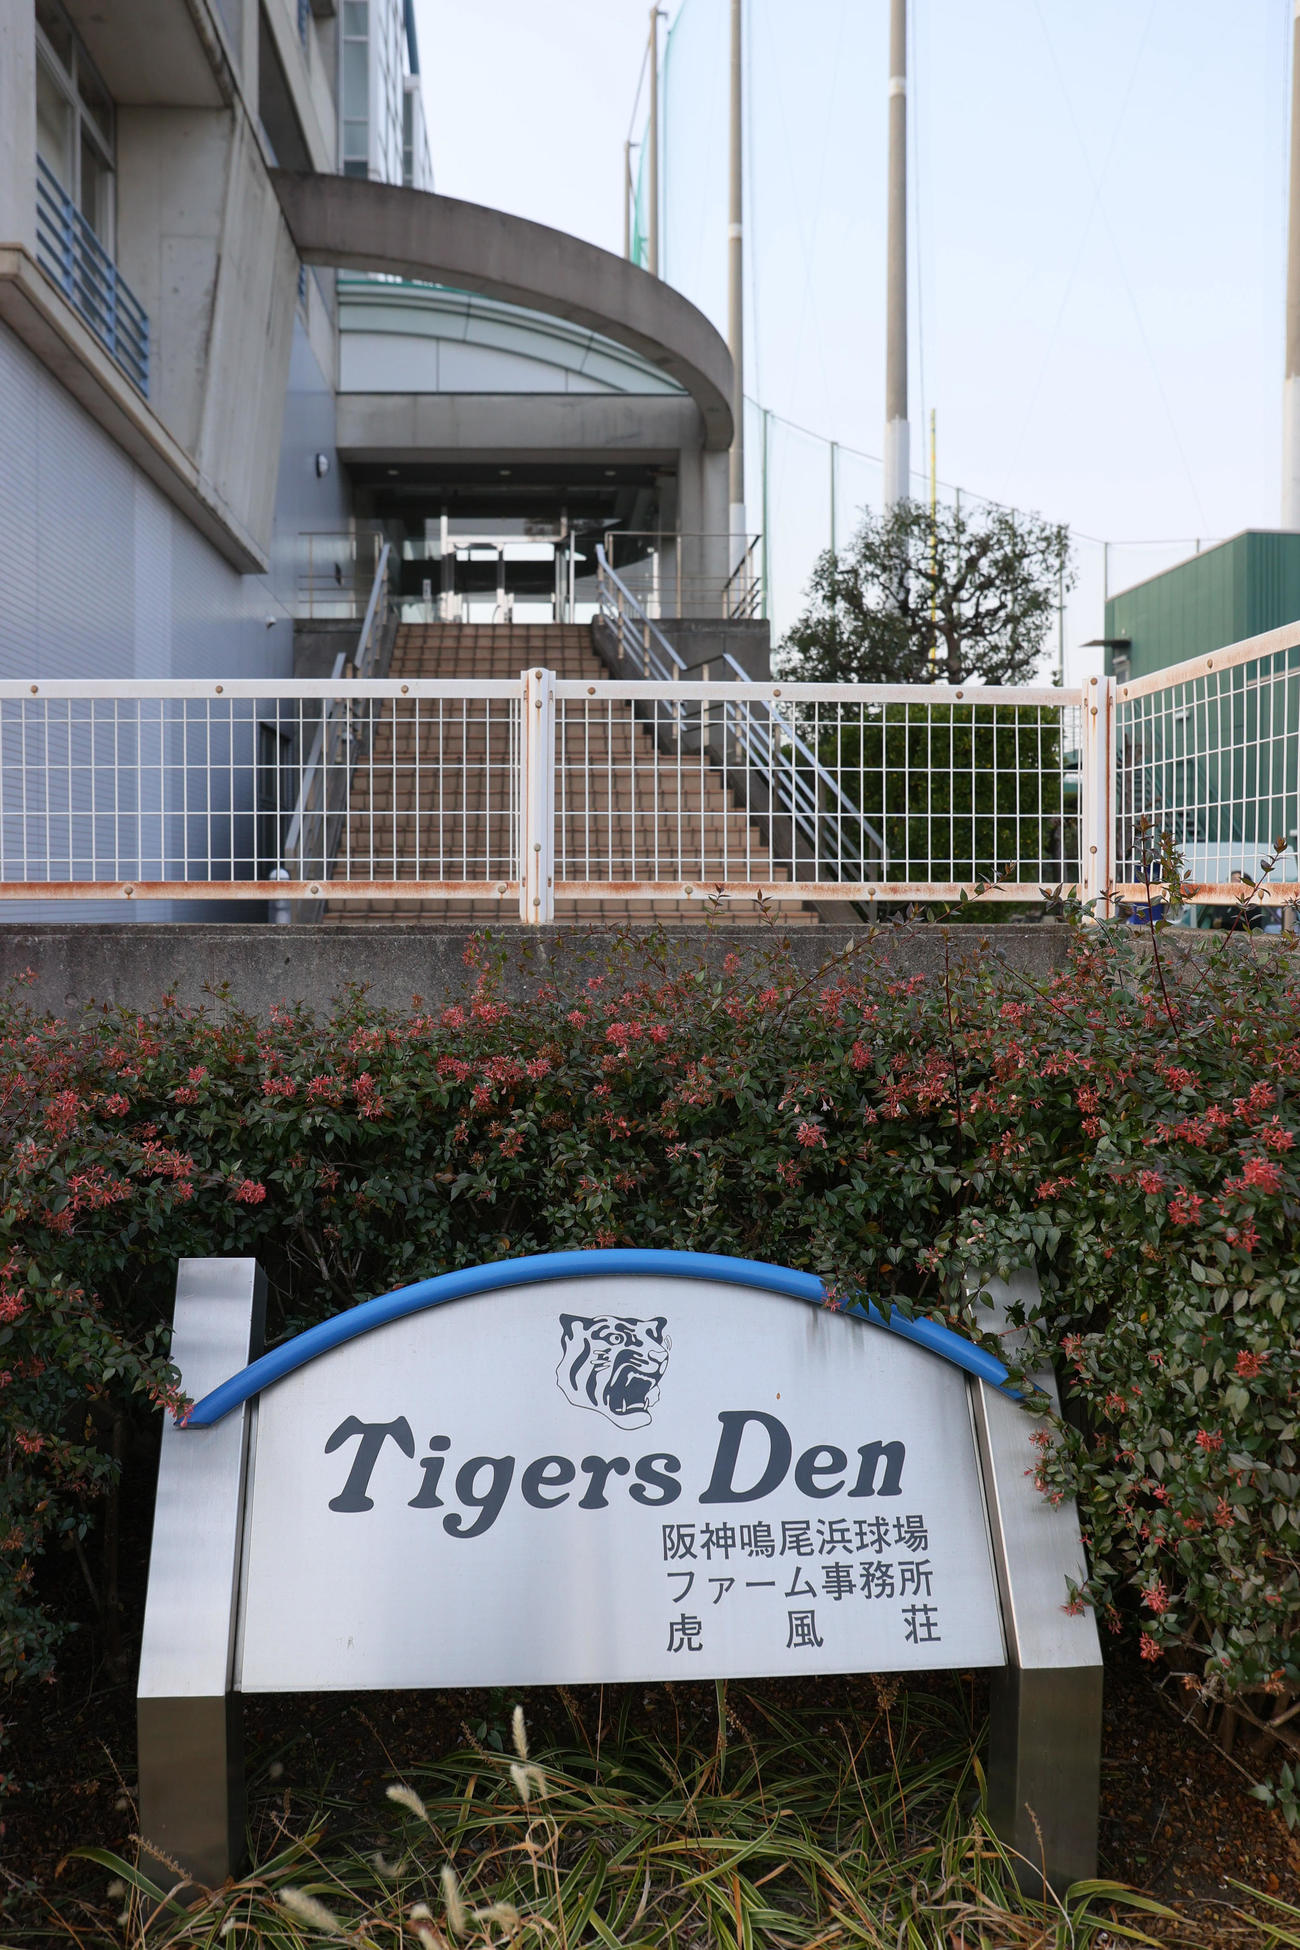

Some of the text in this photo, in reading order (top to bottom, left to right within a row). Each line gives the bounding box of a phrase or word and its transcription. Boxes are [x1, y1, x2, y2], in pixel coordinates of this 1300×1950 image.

[324, 1410, 906, 1539] Tigers Den
[662, 1514, 929, 1561] 阪神鳴尾浜球場
[666, 1558, 934, 1605] ファーム事務所
